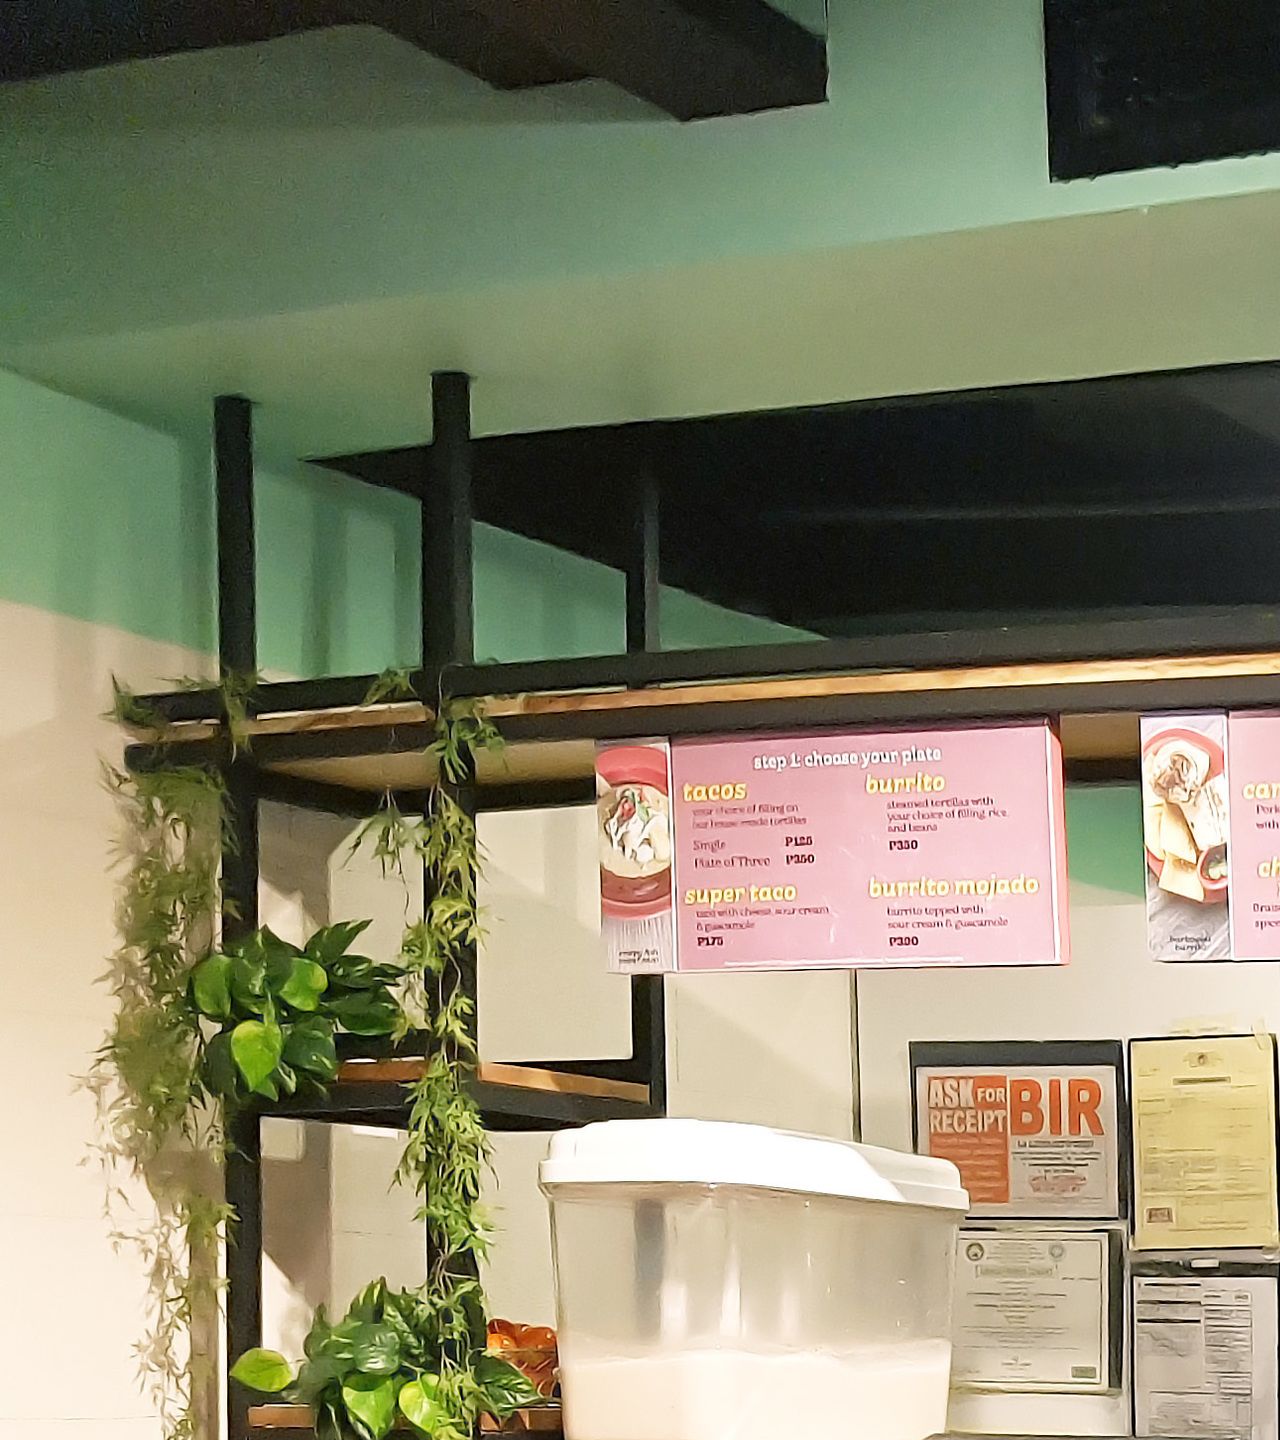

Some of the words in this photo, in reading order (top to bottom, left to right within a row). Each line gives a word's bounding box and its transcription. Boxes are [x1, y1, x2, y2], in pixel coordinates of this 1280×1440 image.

[804, 750, 859, 768] choose
[861, 749, 898, 768] your
[902, 745, 942, 766] plate
[682, 782, 748, 802] tacos
[865, 772, 946, 795] burrito
[685, 886, 746, 909] super
[749, 884, 797, 903] taco
[868, 875, 950, 898] burrito
[953, 872, 1040, 901] mojado
[928, 1077, 975, 1109] ASK
[976, 1086, 1007, 1104] FOR
[1010, 1078, 1105, 1136] BIR
[929, 1109, 1008, 1134] RECEIPT
